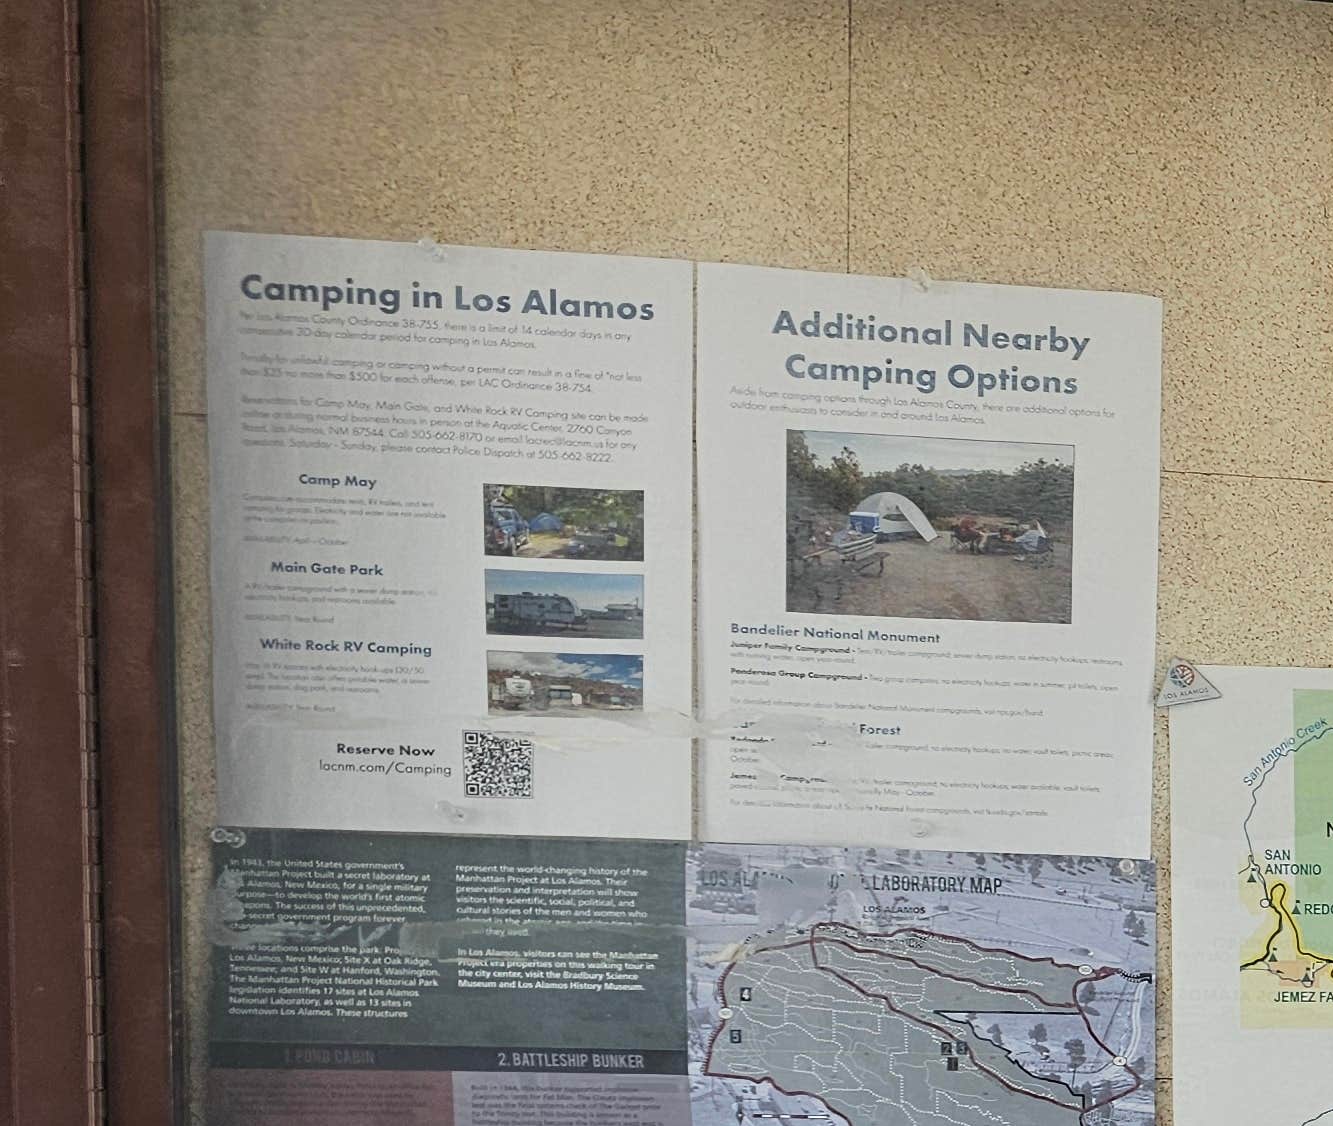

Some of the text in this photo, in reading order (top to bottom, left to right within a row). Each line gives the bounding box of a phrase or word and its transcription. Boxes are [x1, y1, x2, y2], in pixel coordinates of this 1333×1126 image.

[241, 275, 654, 321] Camping in Los Alamos
[772, 310, 1090, 361] Additional Nearby
[786, 354, 1077, 402] Camping Options
[271, 562, 383, 576] Main Gate Park
[320, 759, 451, 777] lacnm.com/Camping
